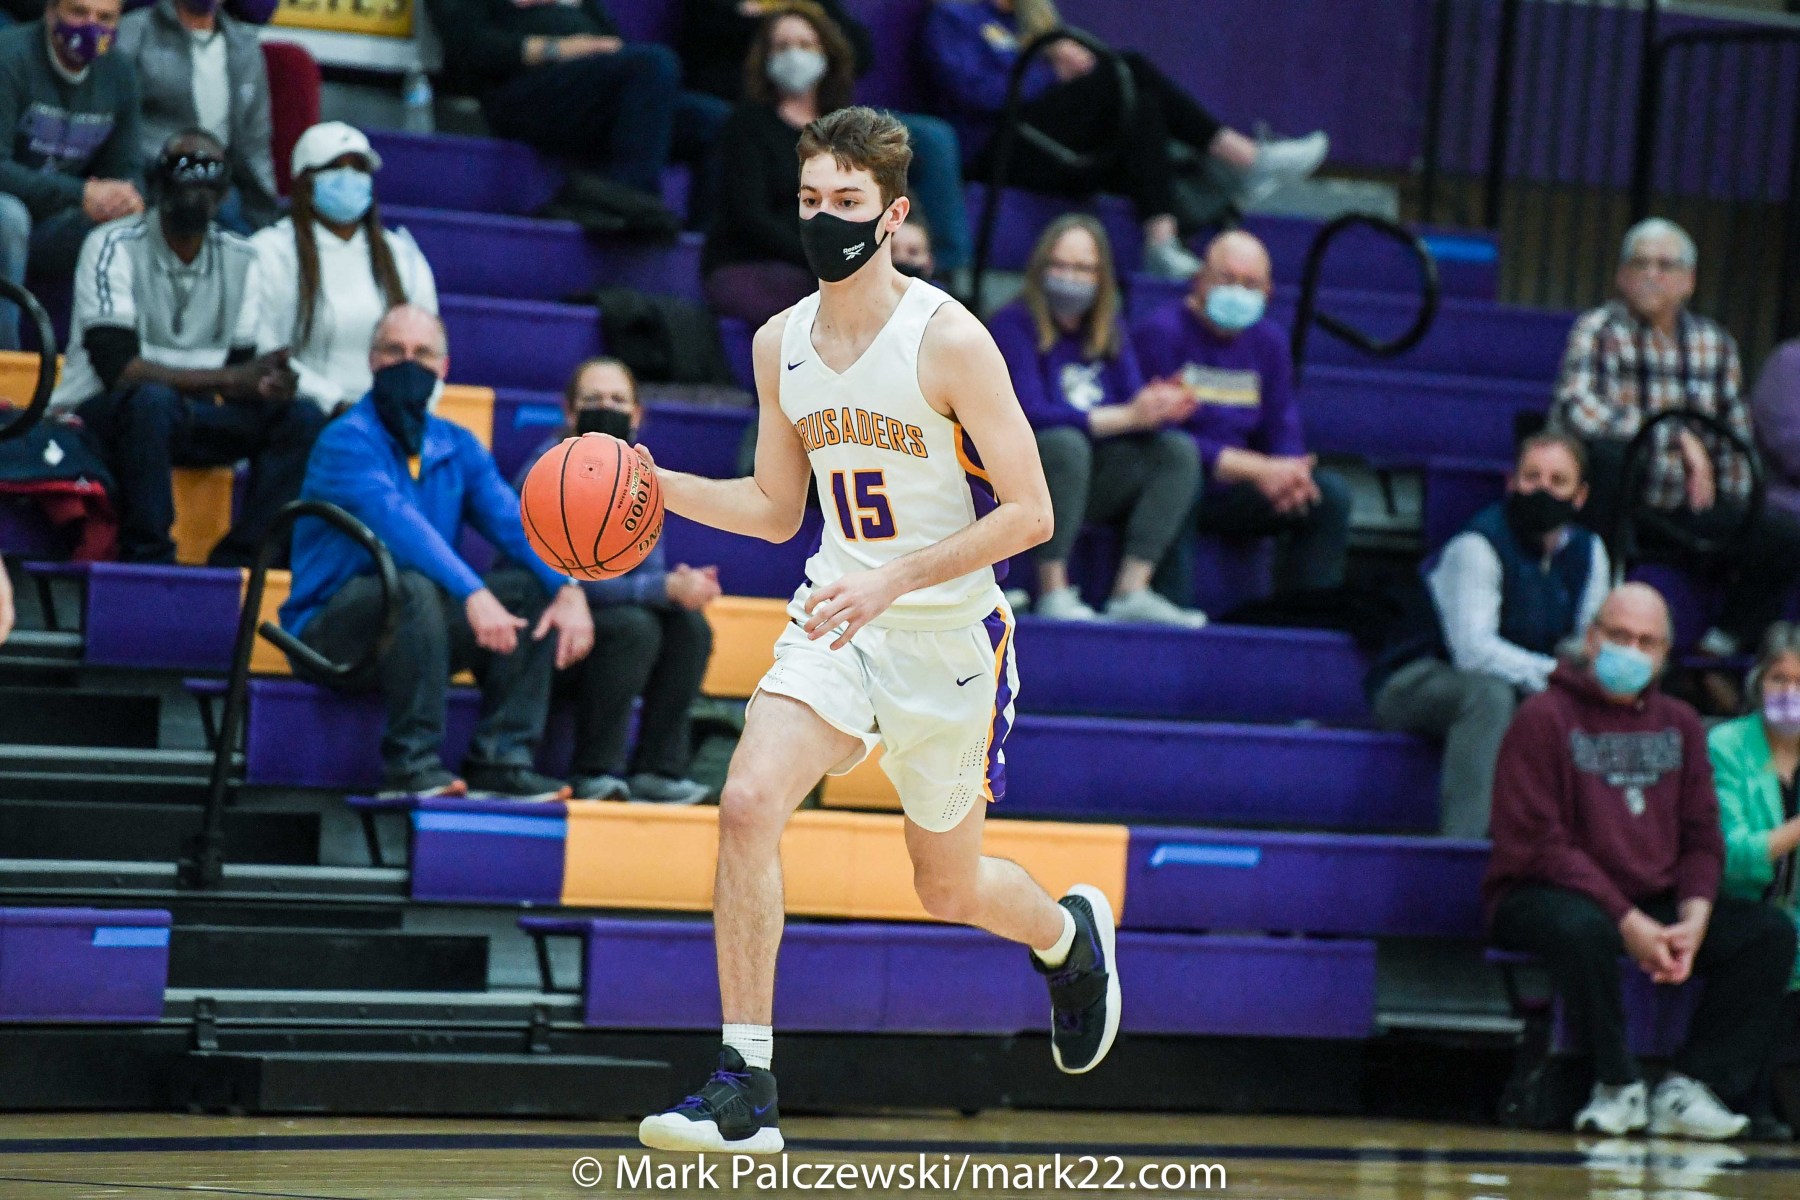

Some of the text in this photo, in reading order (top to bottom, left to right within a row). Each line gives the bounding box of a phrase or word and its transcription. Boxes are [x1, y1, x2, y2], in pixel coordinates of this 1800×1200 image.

[843, 242, 865, 254] Reebok
[794, 406, 928, 459] RUSADERS
[829, 468, 899, 543] 15
